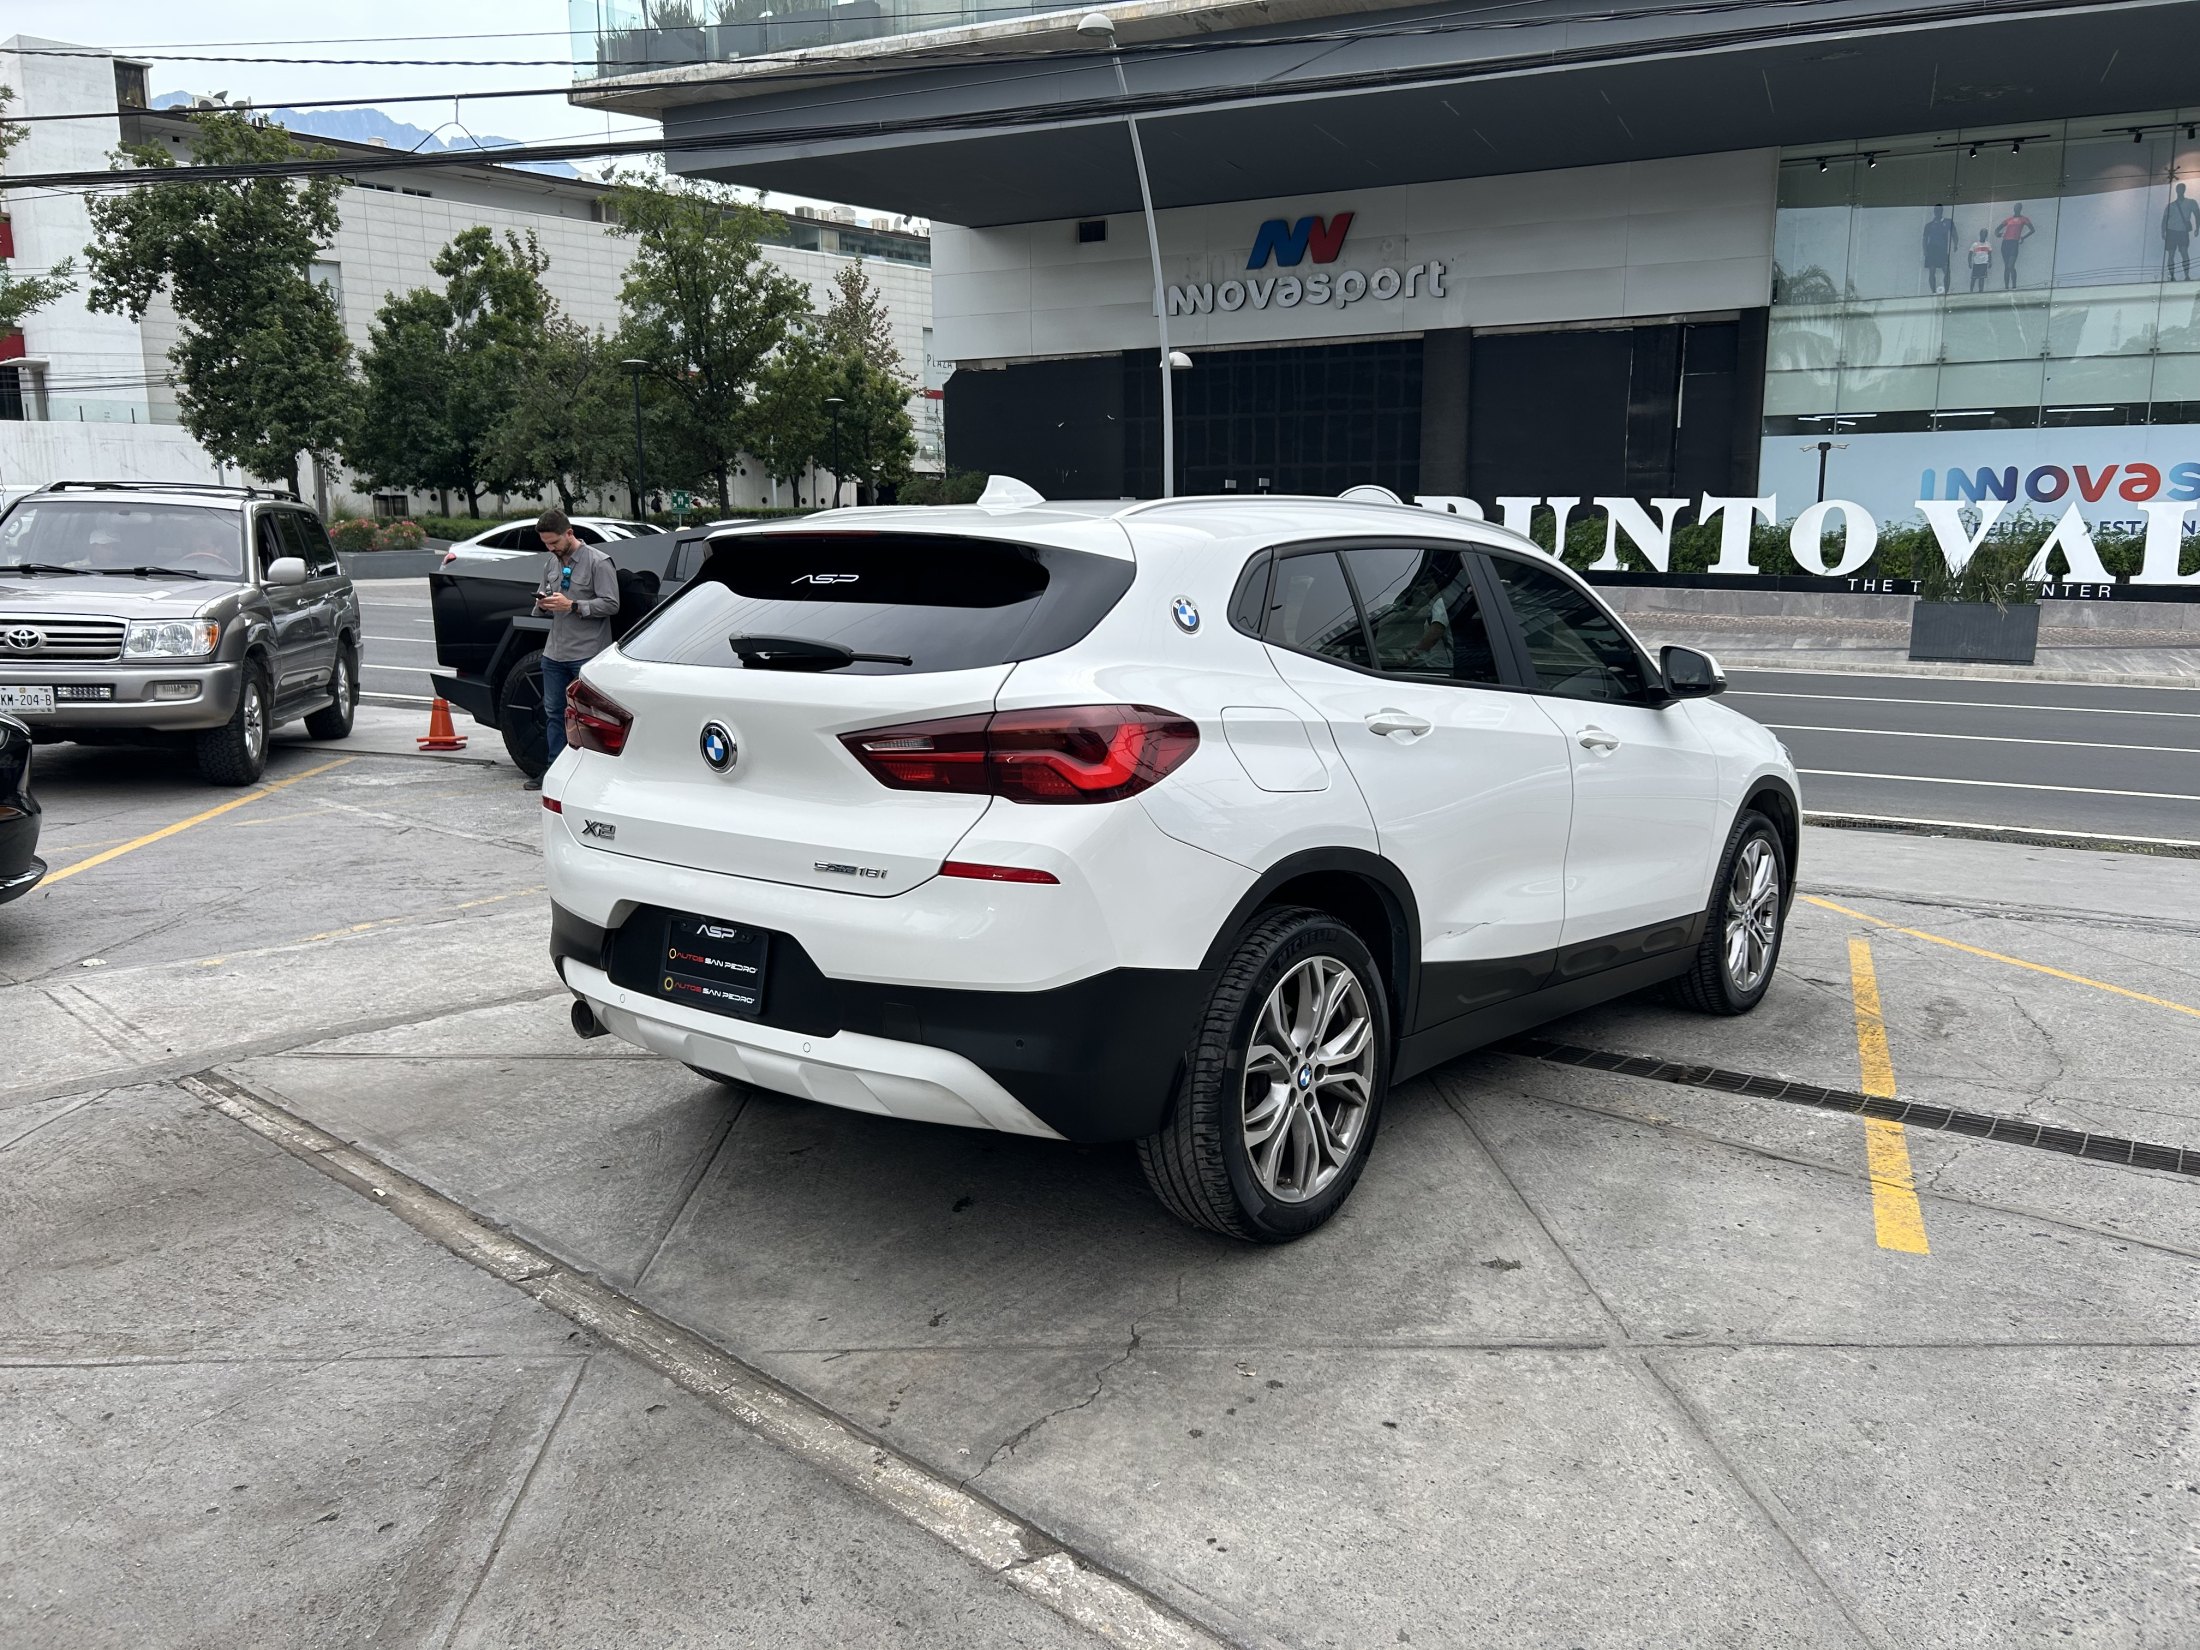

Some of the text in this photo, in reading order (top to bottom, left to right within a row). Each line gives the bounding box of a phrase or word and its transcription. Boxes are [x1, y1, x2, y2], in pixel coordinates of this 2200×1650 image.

[1914, 499, 2200, 584] VAL
[790, 574, 860, 584] ASP
[1847, 578, 1893, 592] THE
[2004, 582, 2112, 599] CENTER
[581, 819, 617, 841] X2
[696, 924, 737, 939] ASP
[676, 952, 758, 974] AUTOS SAN PEDRO
[702, 987, 722, 998] SAN
[722, 991, 755, 1004] PEDRO
